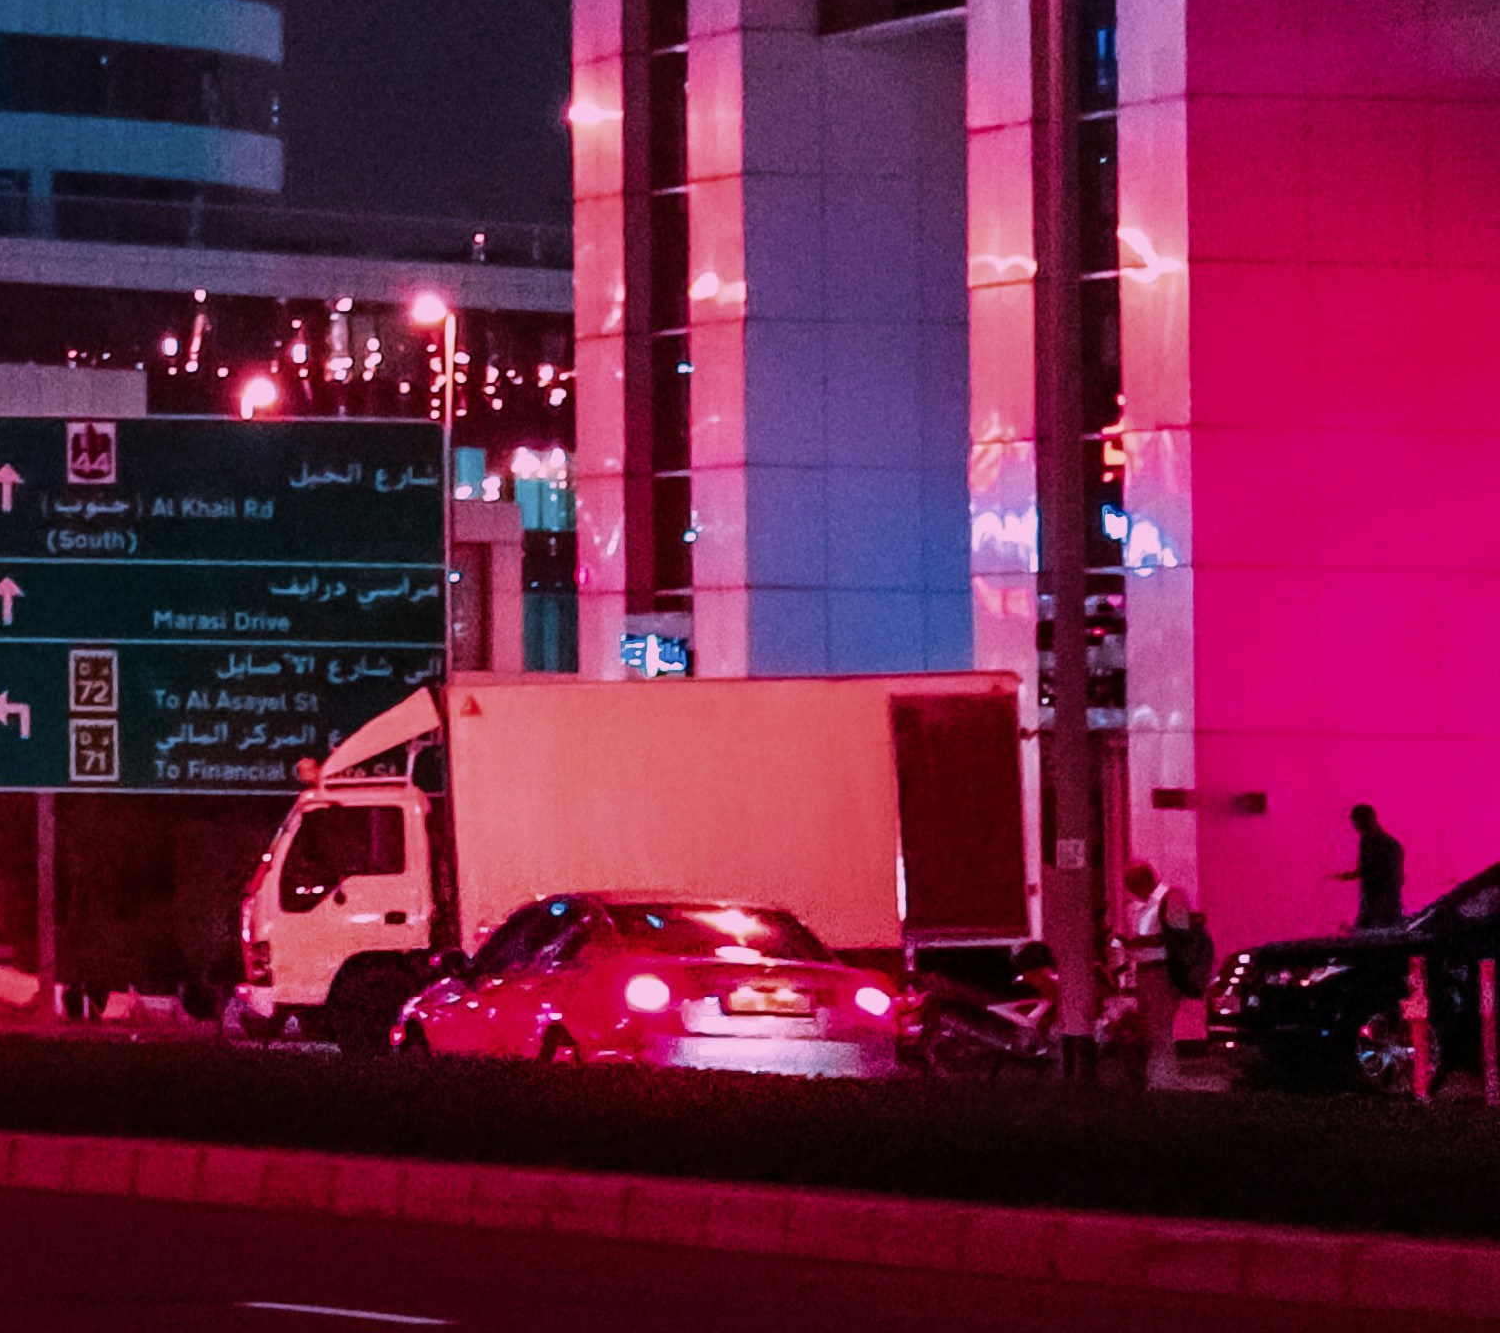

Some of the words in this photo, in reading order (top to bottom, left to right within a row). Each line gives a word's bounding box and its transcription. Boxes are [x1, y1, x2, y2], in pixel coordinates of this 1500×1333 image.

[152, 497, 175, 517] Al
[182, 497, 236, 518] Khail
[244, 498, 275, 519] Rd
[46, 530, 139, 555] (South)
[154, 610, 228, 631] Marasi
[235, 612, 292, 632] Drive
[78, 679, 110, 703] 72
[155, 688, 181, 710] To
[186, 689, 210, 710] Al
[216, 690, 288, 715] Asayel
[294, 691, 319, 712] St
[80, 749, 107, 772] 71
[155, 760, 181, 780] To
[187, 760, 287, 781] Financial
